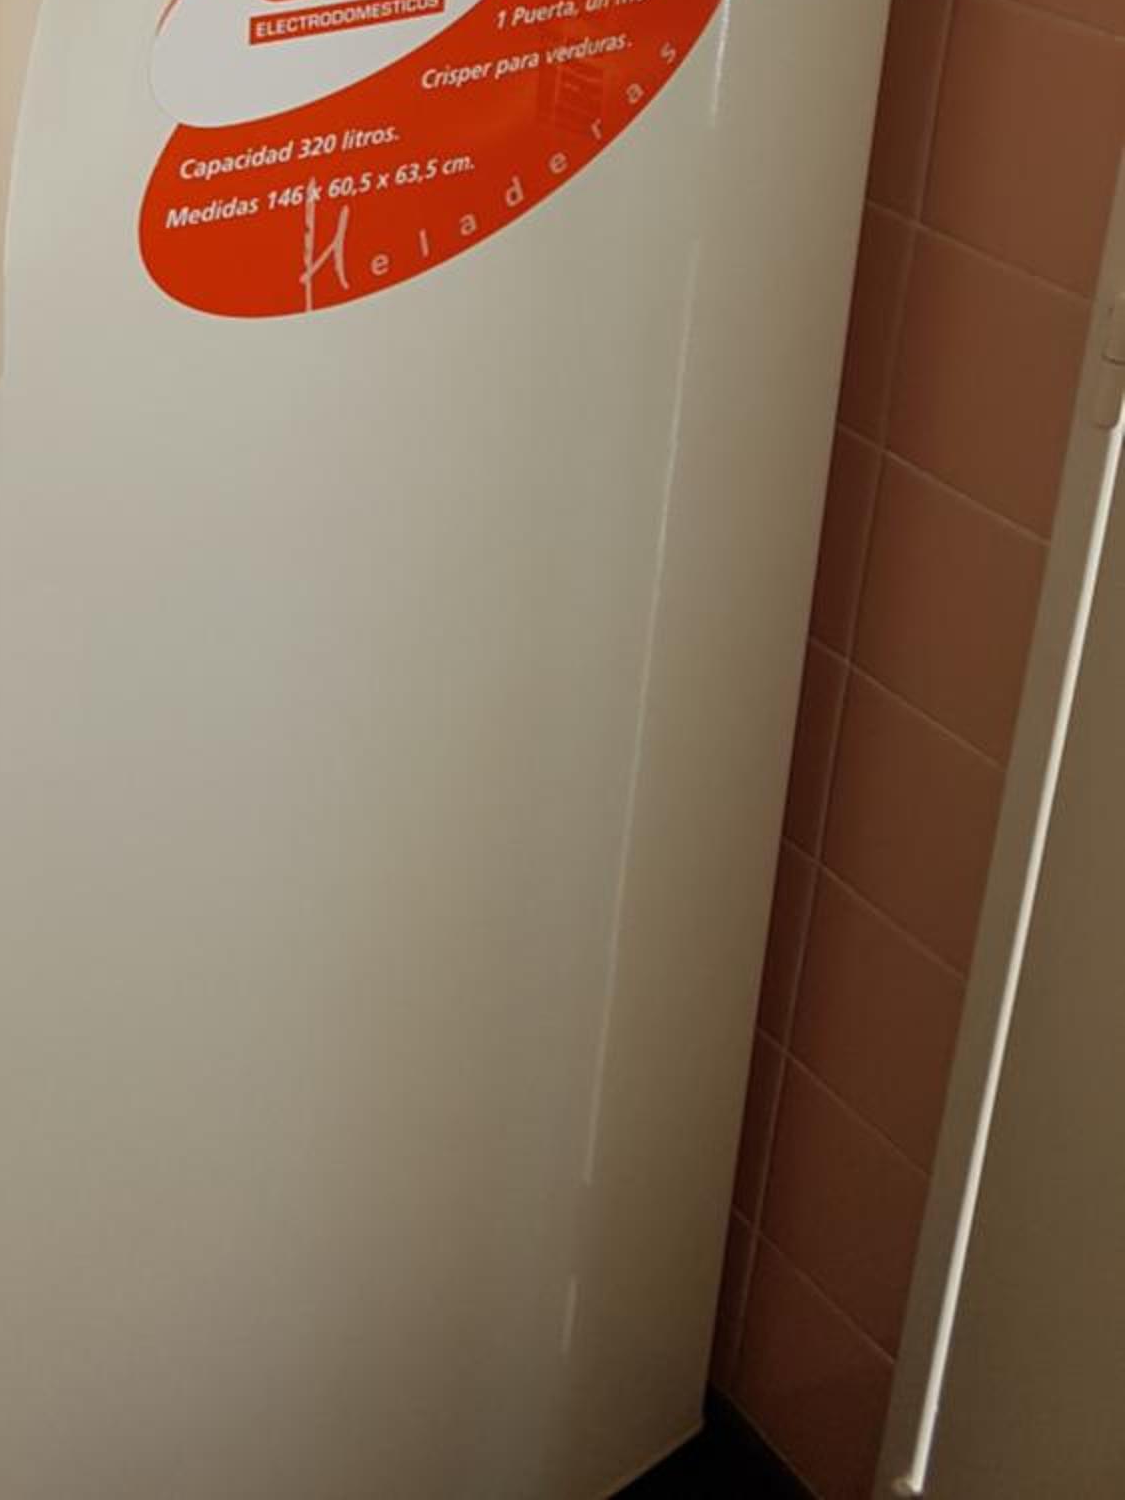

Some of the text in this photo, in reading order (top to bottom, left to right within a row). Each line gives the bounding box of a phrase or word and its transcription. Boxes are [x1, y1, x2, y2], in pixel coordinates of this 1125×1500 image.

[497, 10, 506, 29] 1
[421, 33, 632, 89] Crisper para verduras.
[179, 126, 400, 180] Capacidad 320 litros.
[165, 195, 259, 229] Medidas
[267, 187, 304, 210] 146
[328, 172, 372, 198] 60,5
[376, 175, 389, 189] x
[394, 159, 438, 184] 63,5
[442, 154, 475, 175] cm.
